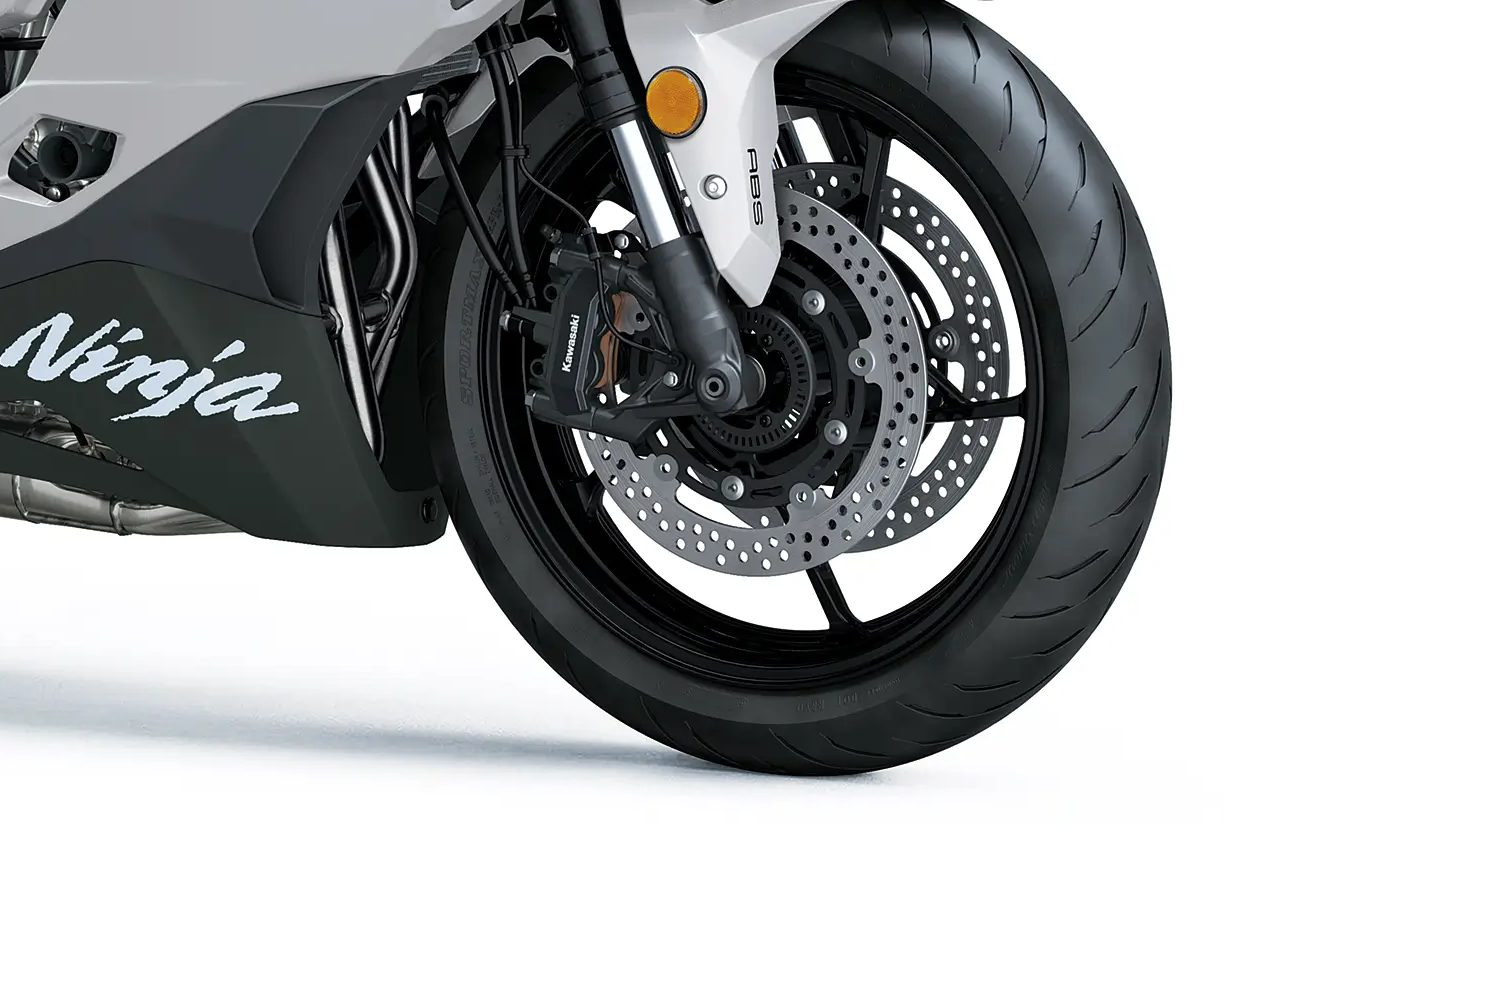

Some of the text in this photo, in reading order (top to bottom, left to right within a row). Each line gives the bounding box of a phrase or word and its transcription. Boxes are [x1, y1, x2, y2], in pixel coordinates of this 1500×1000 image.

[747, 148, 763, 226] ABS
[0, 312, 299, 422] Ninja
[561, 314, 580, 372] Kawasaki
